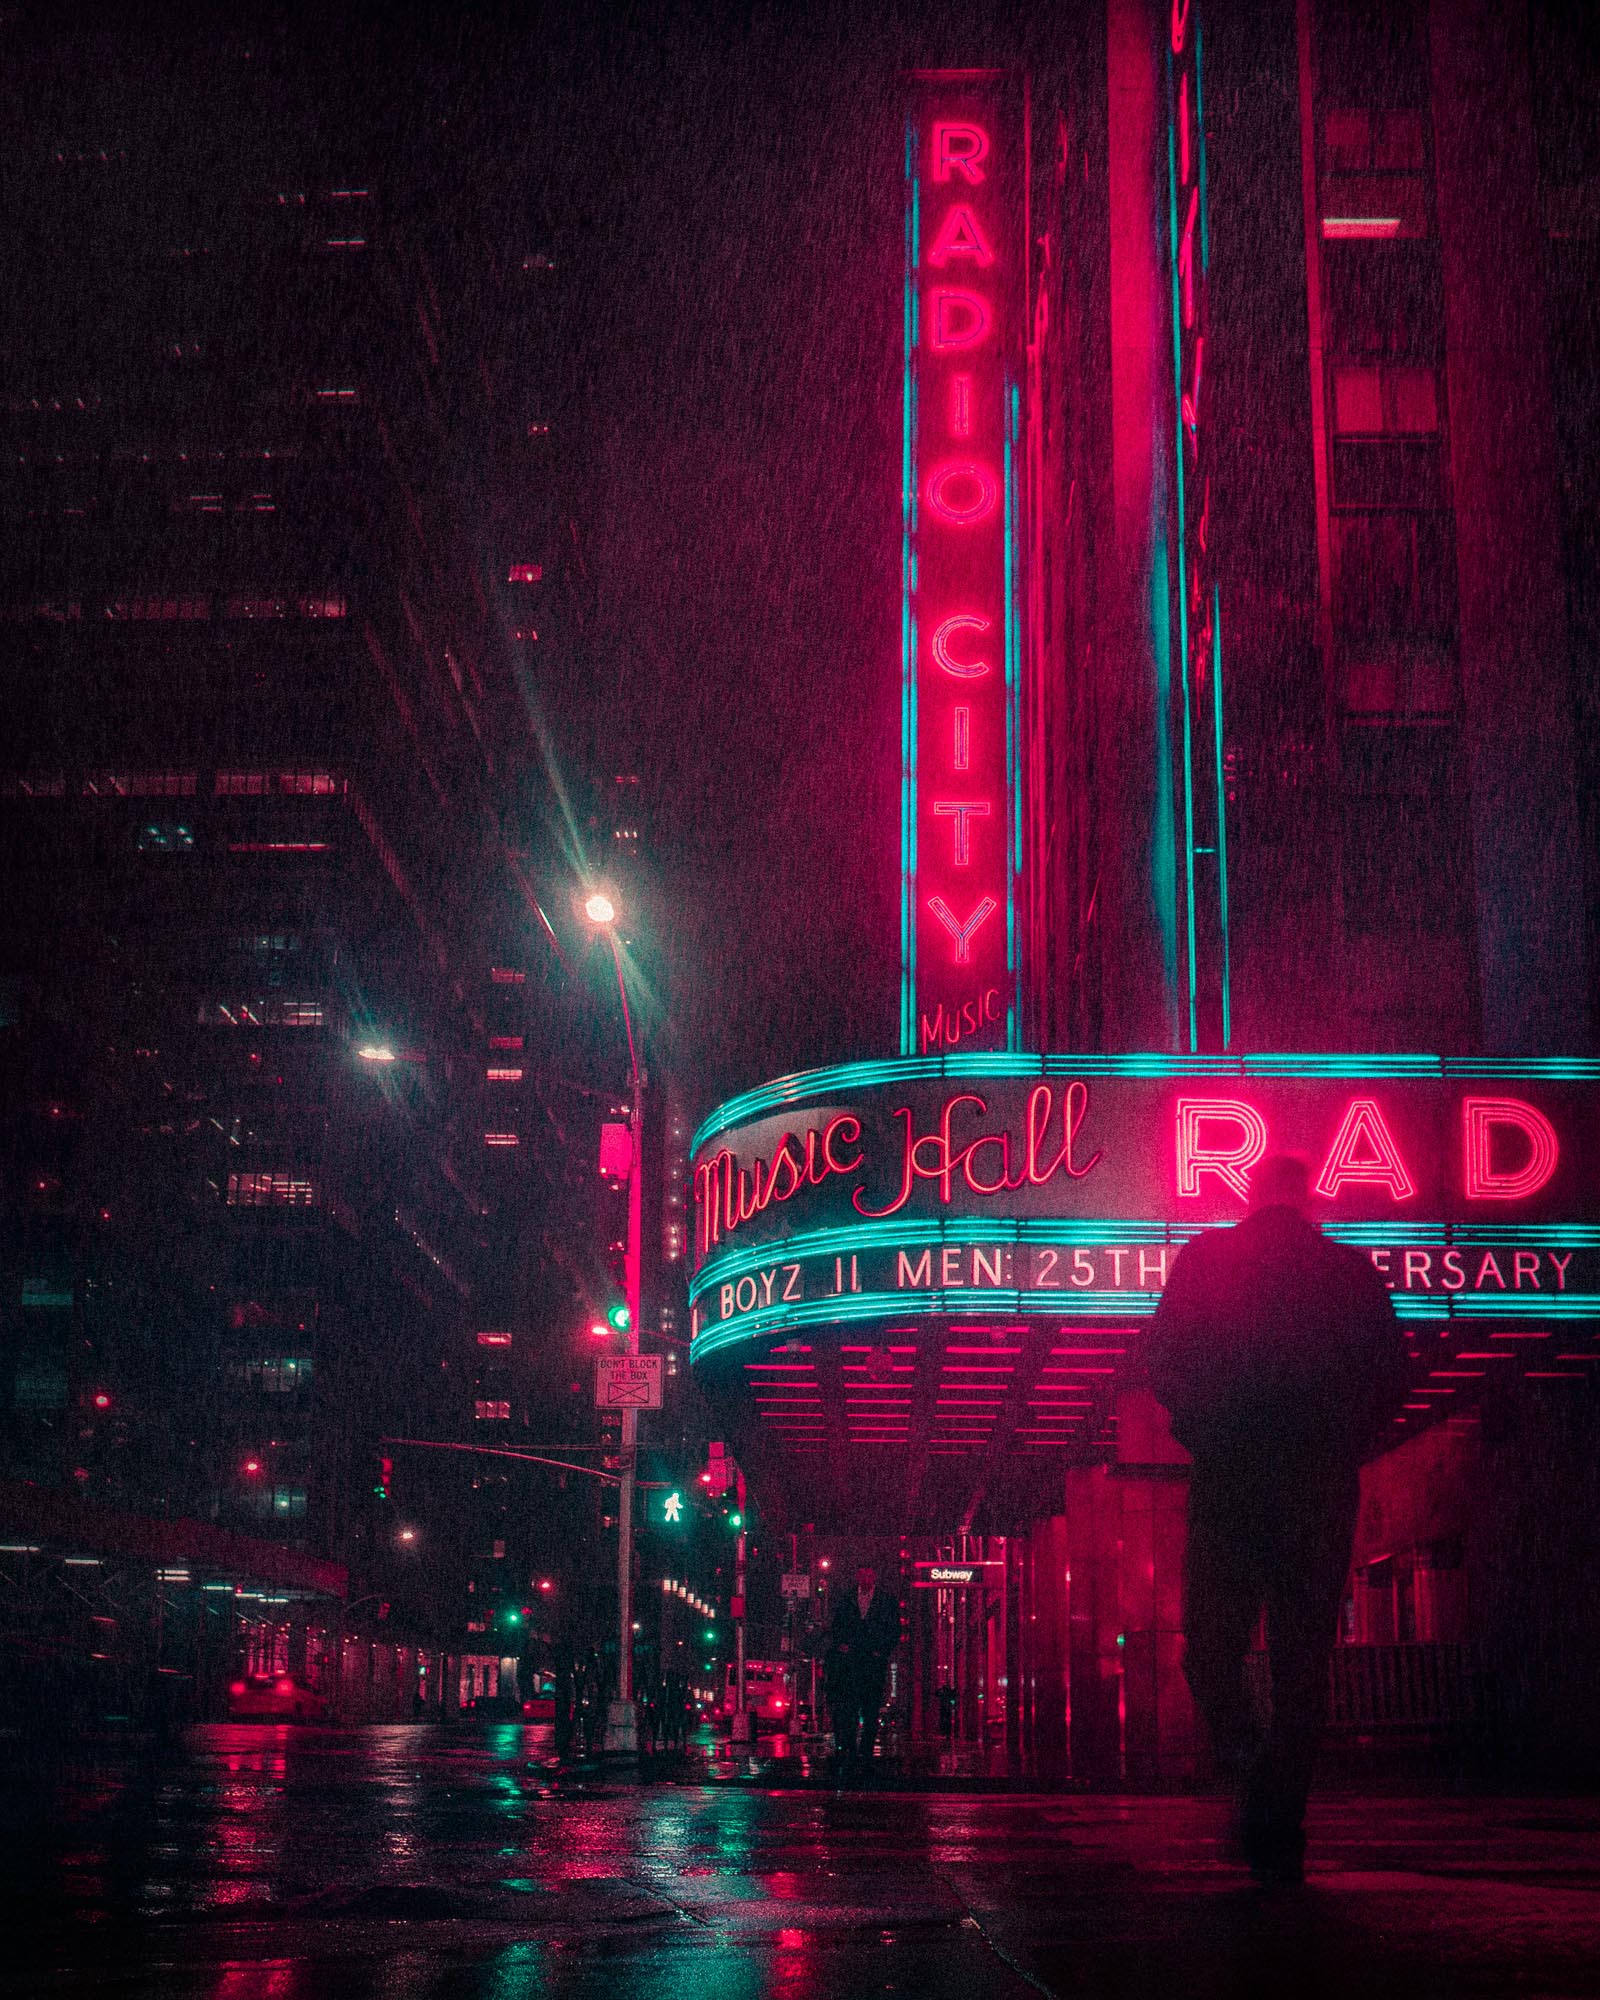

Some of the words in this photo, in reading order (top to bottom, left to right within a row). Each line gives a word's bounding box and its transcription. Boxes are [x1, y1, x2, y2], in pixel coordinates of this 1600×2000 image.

[928, 121, 997, 526] RADIO
[927, 613, 997, 965] CITY
[852, 1081, 1102, 1217] Hall
[1175, 1097, 1560, 1201] RAD
[720, 1264, 801, 1320] BOYZ
[835, 1254, 860, 1293] II
[897, 1249, 1013, 1288] MEN:
[1036, 1249, 1168, 1287] 25TH
[1370, 1250, 1573, 1291] ERSARY
[611, 1370, 626, 1380] THE
[630, 1370, 648, 1380] BOX
[628, 1359, 658, 1369] BLOCK
[930, 1568, 973, 1582] Subway
